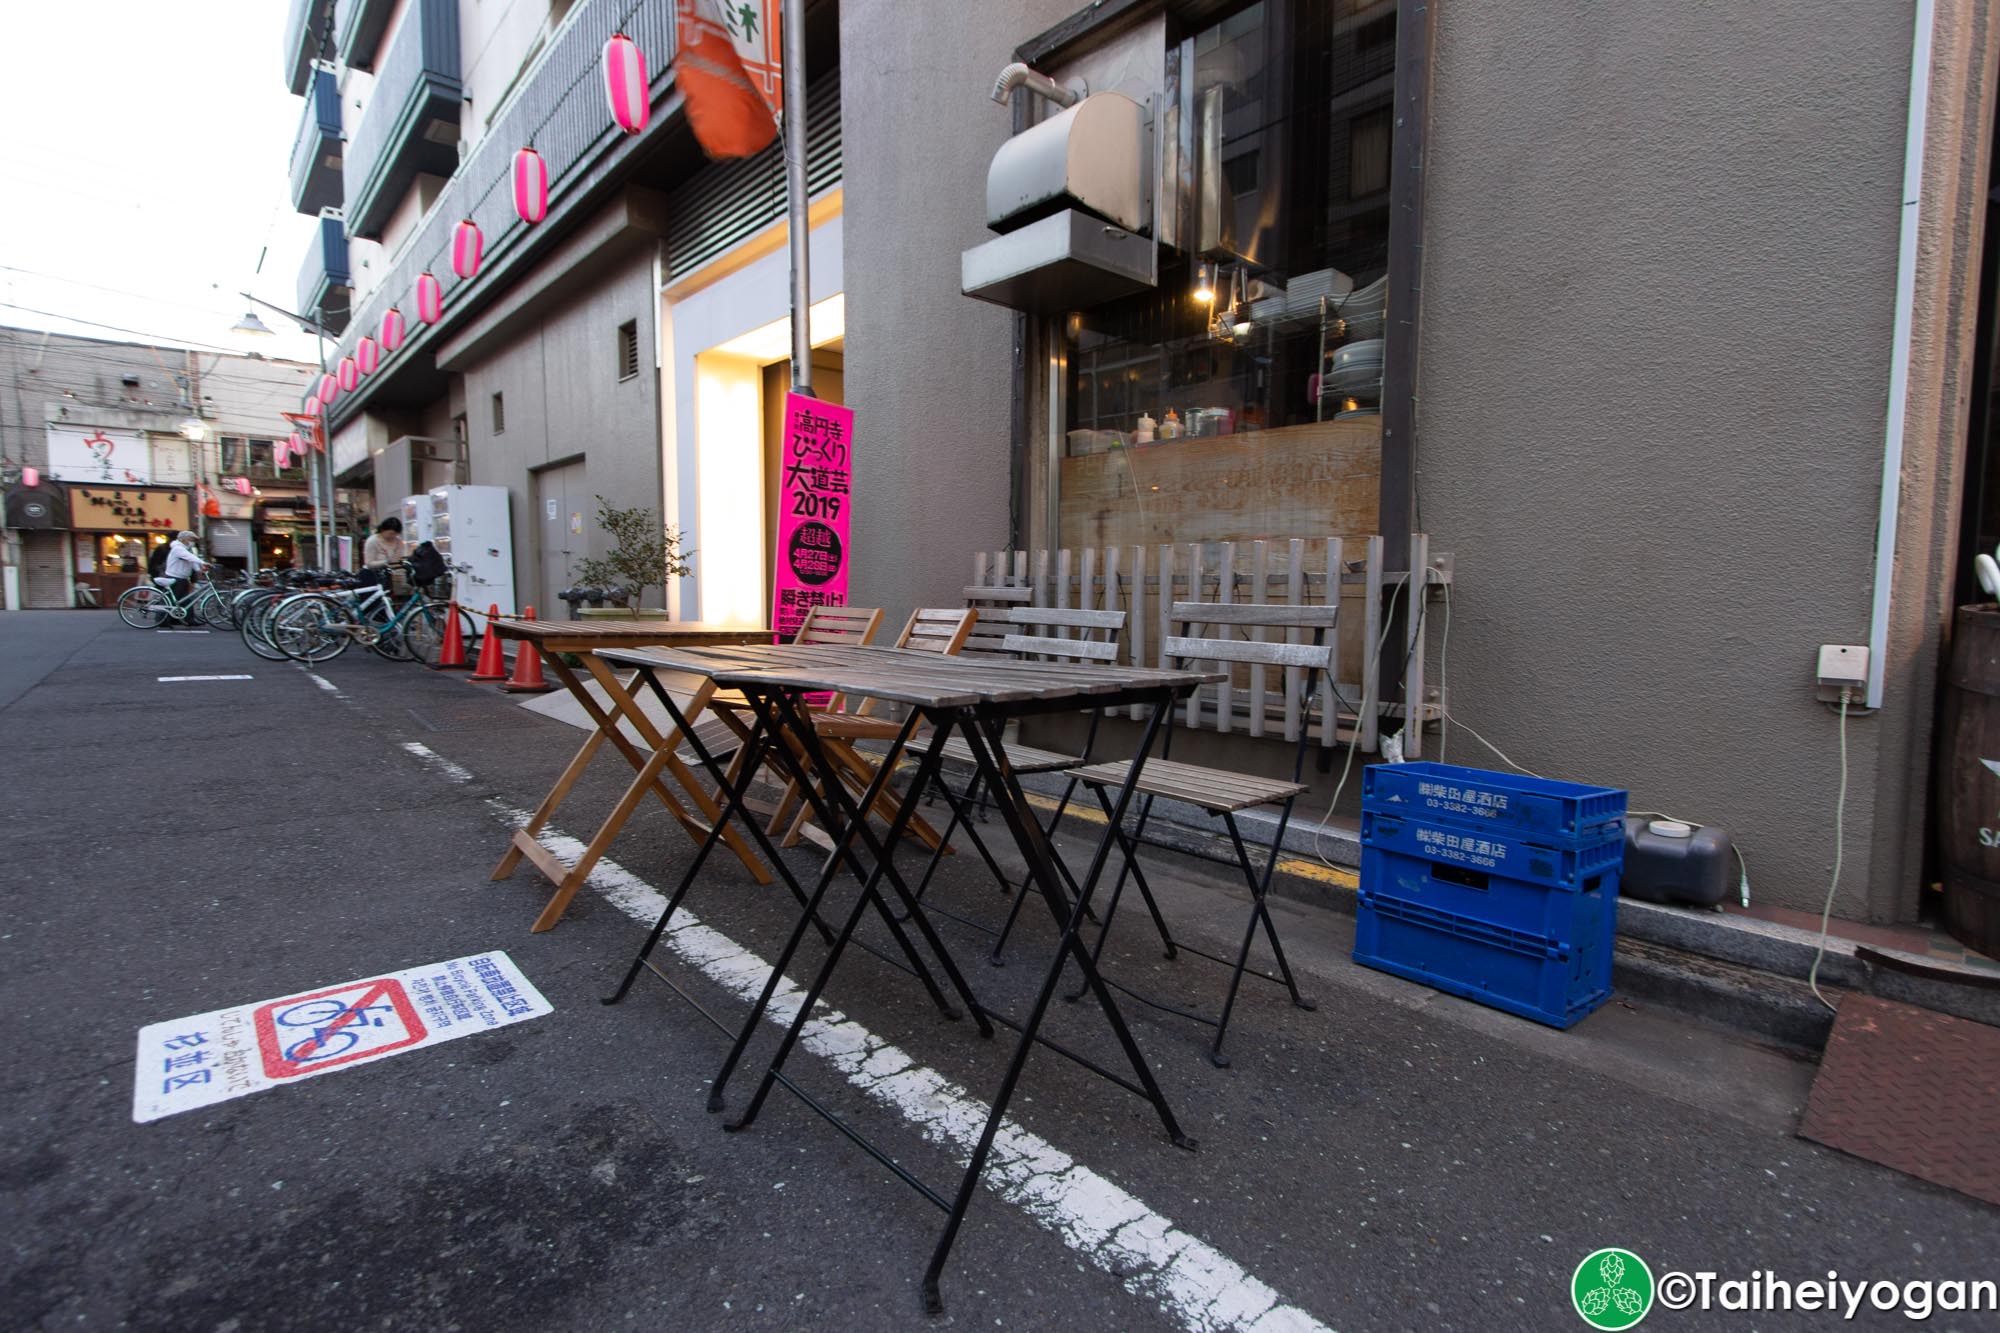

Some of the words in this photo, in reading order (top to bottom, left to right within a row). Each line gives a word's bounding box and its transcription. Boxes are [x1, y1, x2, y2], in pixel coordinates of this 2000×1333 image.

[800, 409, 843, 441] 高円寺
[793, 434, 847, 468] びっくり
[786, 459, 849, 494] 大道芸
[792, 490, 841, 520] 2019
[799, 527, 831, 548] 超越
[1424, 845, 1496, 868] 03-3382-3666
[444, 961, 459, 970] No
[450, 968, 473, 990] Bicycle
[466, 987, 488, 1012] Parking
[468, 957, 534, 1017] 自転車放置禁止区域
[479, 1009, 499, 1026] Zone
[162, 1031, 212, 1094] 杉並区
